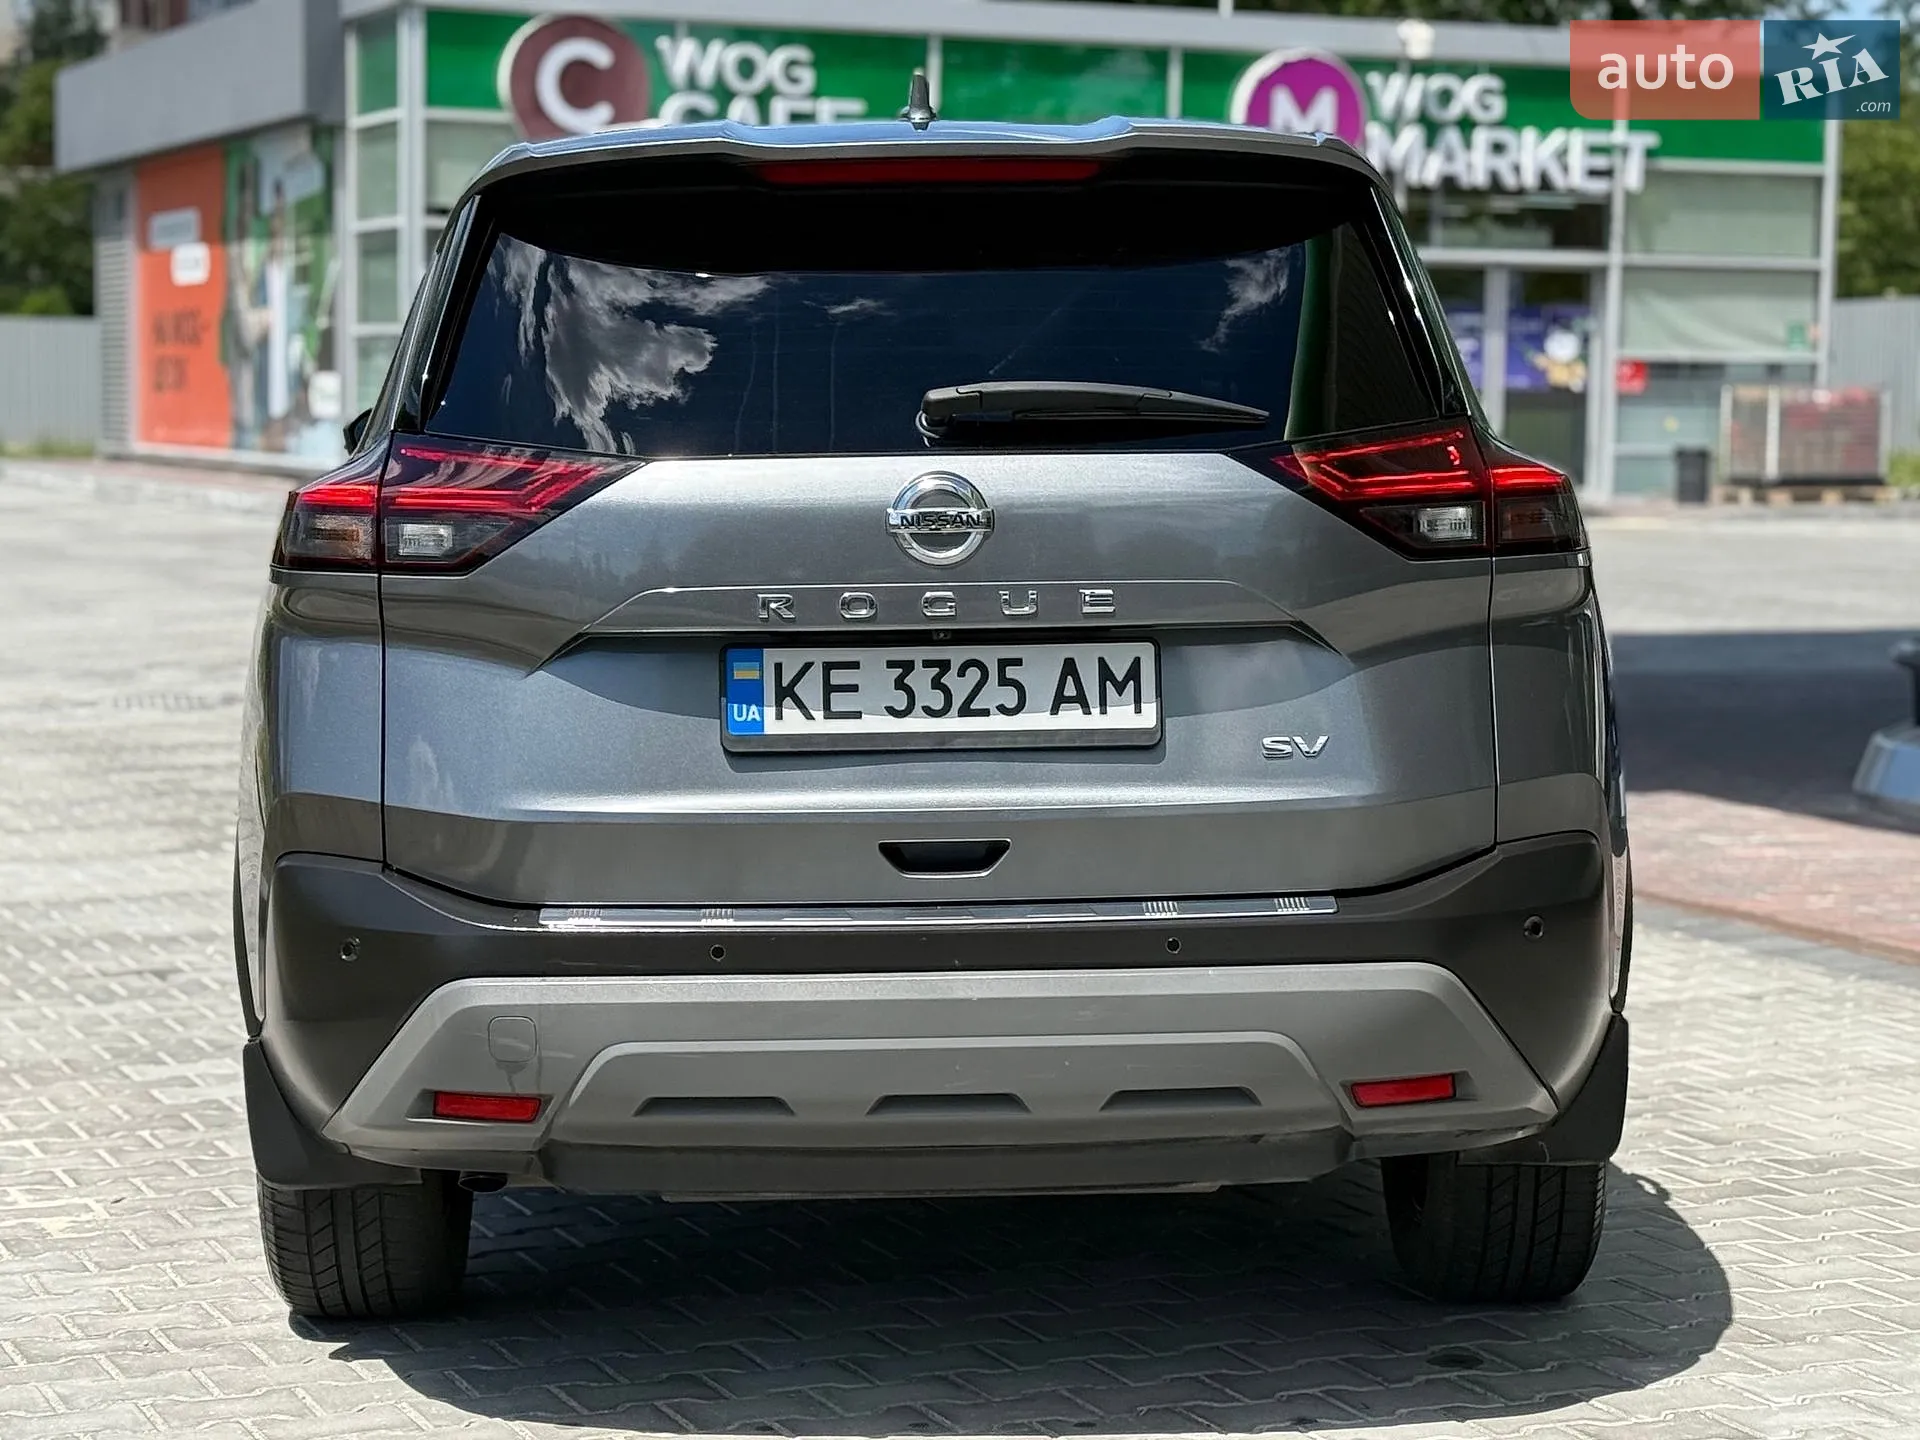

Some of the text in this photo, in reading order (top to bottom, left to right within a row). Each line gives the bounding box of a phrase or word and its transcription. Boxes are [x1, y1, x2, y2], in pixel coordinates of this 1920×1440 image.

[654, 35, 816, 96] WOG
[1366, 71, 1507, 124] WOG
[1365, 120, 1660, 195] MARKET
[900, 513, 980, 528] NISSAN
[757, 589, 1116, 620] ROGUE
[773, 656, 1142, 720] KE 3325 AM
[733, 704, 760, 722] UA
[1262, 735, 1330, 759] SV
